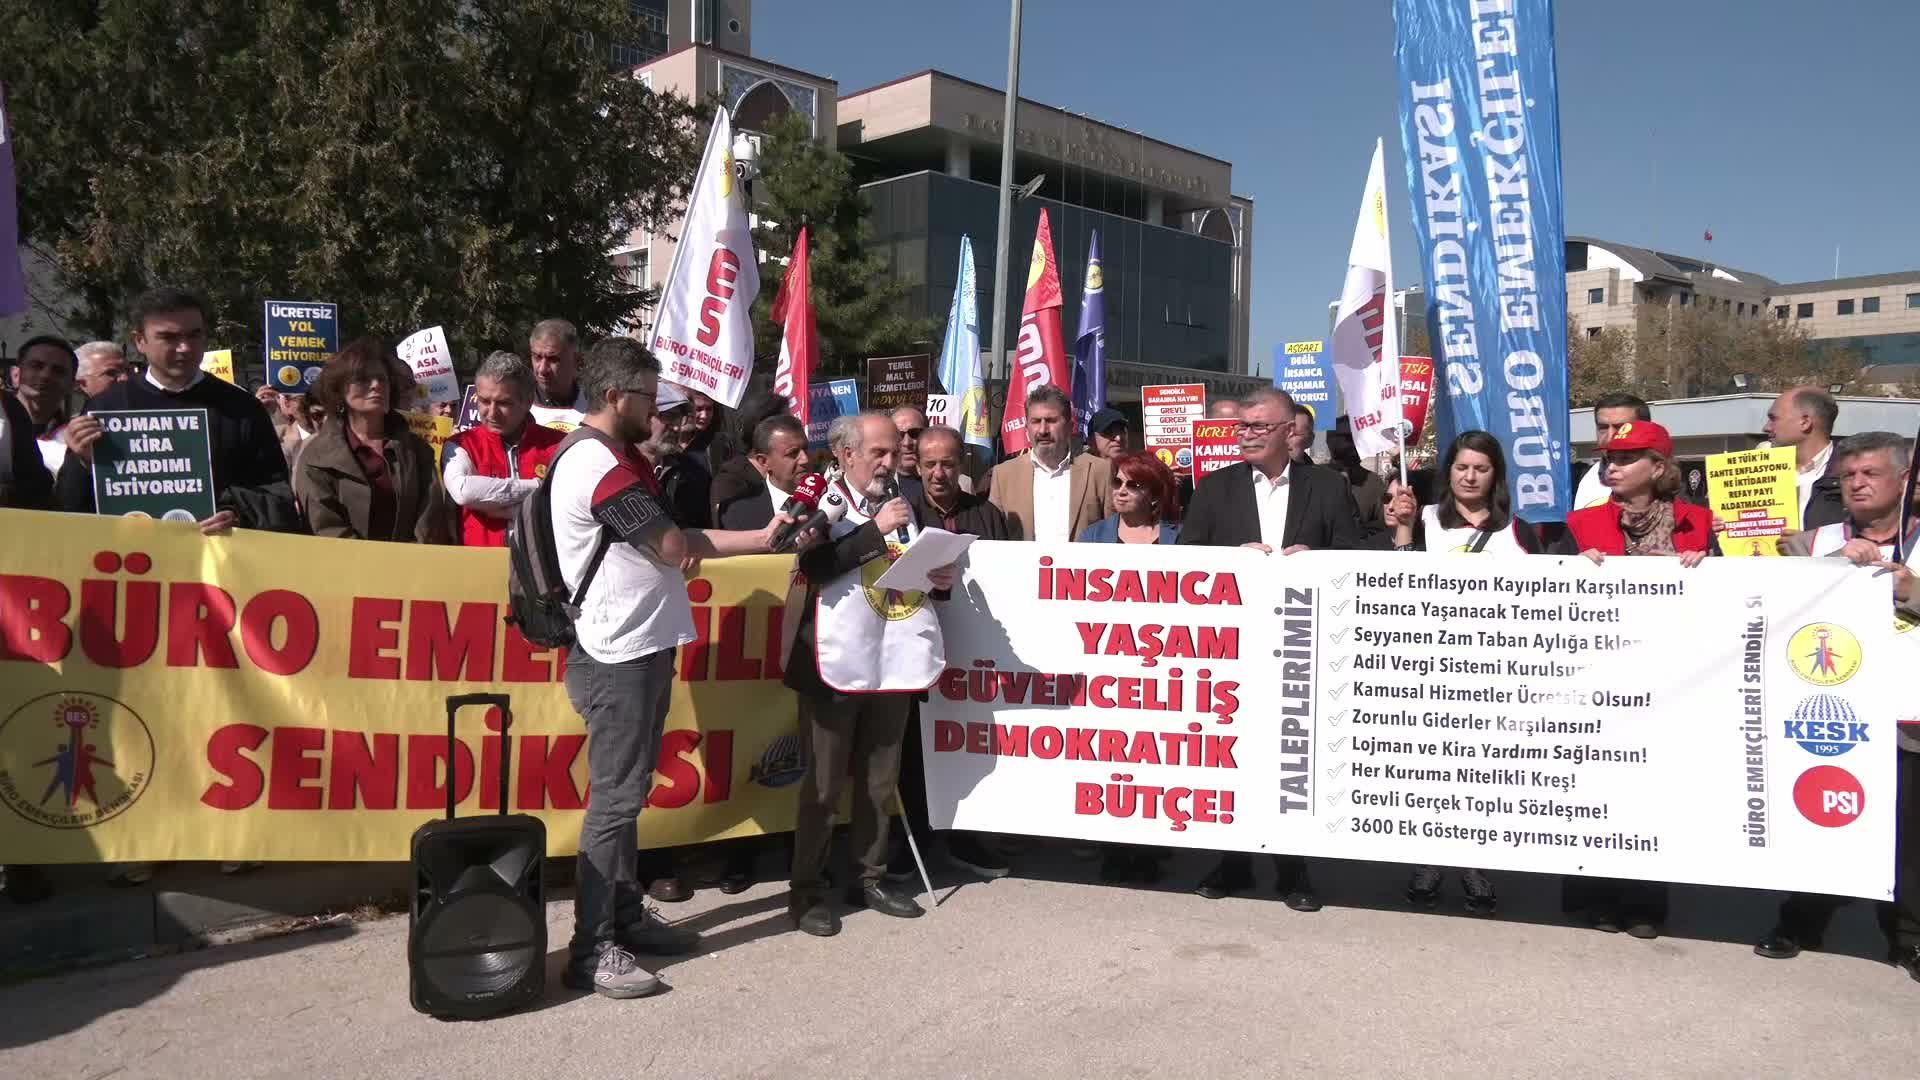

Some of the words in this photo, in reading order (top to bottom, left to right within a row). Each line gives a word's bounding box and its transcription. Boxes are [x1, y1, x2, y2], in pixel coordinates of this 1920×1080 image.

[271, 304, 333, 319] ÜCRETSİZ
[289, 321, 315, 332] YOL
[279, 336, 326, 348] YEMEK
[655, 335, 688, 357] BÜRO
[689, 348, 745, 380] EMEKÇİLERİ
[888, 361, 912, 370] TEMEL
[886, 372, 903, 381] MAL
[905, 372, 916, 380] VE
[1281, 381, 1325, 393] YAŞAMAK
[1160, 405, 1186, 414] GREVLİ
[1160, 416, 1187, 425] GERÇEK
[176, 416, 199, 430] VE
[129, 434, 174, 453] KİRA
[113, 458, 191, 475] YARDIMI
[1710, 469, 1733, 478] SAHTE
[1727, 457, 1737, 465] NE
[105, 477, 203, 497] İSTİYORUZ!
[1723, 480, 1733, 488] NE
[1754, 488, 1773, 496] PAYI
[1038, 556, 1242, 605] İNSANCA
[1356, 573, 1404, 589] Hedef
[1408, 574, 1488, 593] Enflasyon
[1494, 576, 1570, 595] Kayıpları
[1576, 579, 1684, 599] Karşılansın!
[0, 551, 319, 675] BÜRO
[1355, 596, 1416, 616] İnsanca
[1421, 601, 1506, 622] Yaşanacak
[1511, 605, 1563, 621] Temel
[1568, 604, 1620, 623] Ücret!
[1075, 622, 1240, 667] YAŞAM
[1354, 627, 1433, 649] Seyyanen
[1438, 629, 1472, 646] Zam
[1477, 631, 1527, 648] Taban
[1533, 634, 1588, 653] Aylığa
[1353, 653, 1385, 670] Adil
[1391, 656, 1435, 675] Vergi
[1439, 658, 1501, 675] Sistemi
[939, 659, 1183, 712] GÜVENCELİ
[1196, 668, 1240, 724] İŞ
[1273, 587, 1313, 814] TALEPLERİMİZ
[1353, 681, 1424, 700] Kamusal
[1429, 684, 1513, 703] Hizmetler
[1592, 690, 1651, 708] Olsun!
[1352, 709, 1417, 727] Zorunlu
[1422, 711, 1491, 730] Giderler
[1496, 715, 1601, 736] Karşılansın!
[1784, 720, 1870, 742] KESK
[934, 720, 1239, 768] DEMOKRATİK
[1352, 736, 1412, 756] Lojman
[1417, 743, 1437, 757] ve
[1442, 741, 1476, 759] Kira
[1481, 742, 1548, 760] Yardımı
[1552, 744, 1647, 765] Sağlansın!
[1738, 688, 1768, 793] EMEKÇİLERİ
[1815, 744, 1840, 754] 1995
[200, 707, 734, 811] SENDİKSI
[1351, 763, 1380, 779] Her
[1384, 765, 1451, 782] Kuruma
[1456, 767, 1525, 786] Nitelikli
[1531, 771, 1576, 792] Kreş!
[1075, 773, 1235, 831] BÜTÇE!
[1351, 790, 1399, 808] Grevli
[1404, 792, 1460, 813] Gerçek
[1465, 796, 1513, 817] Toplu
[1518, 799, 1608, 822] Sözleşme!
[1823, 790, 1859, 815] PSI
[1351, 818, 1393, 834] 3600
[1398, 820, 1417, 837] Ek
[1422, 821, 1497, 844] Gösterge
[1502, 828, 1577, 849] ayrımsız
[1582, 833, 1658, 852] verilsin!
[1743, 797, 1766, 848] BÜRO
